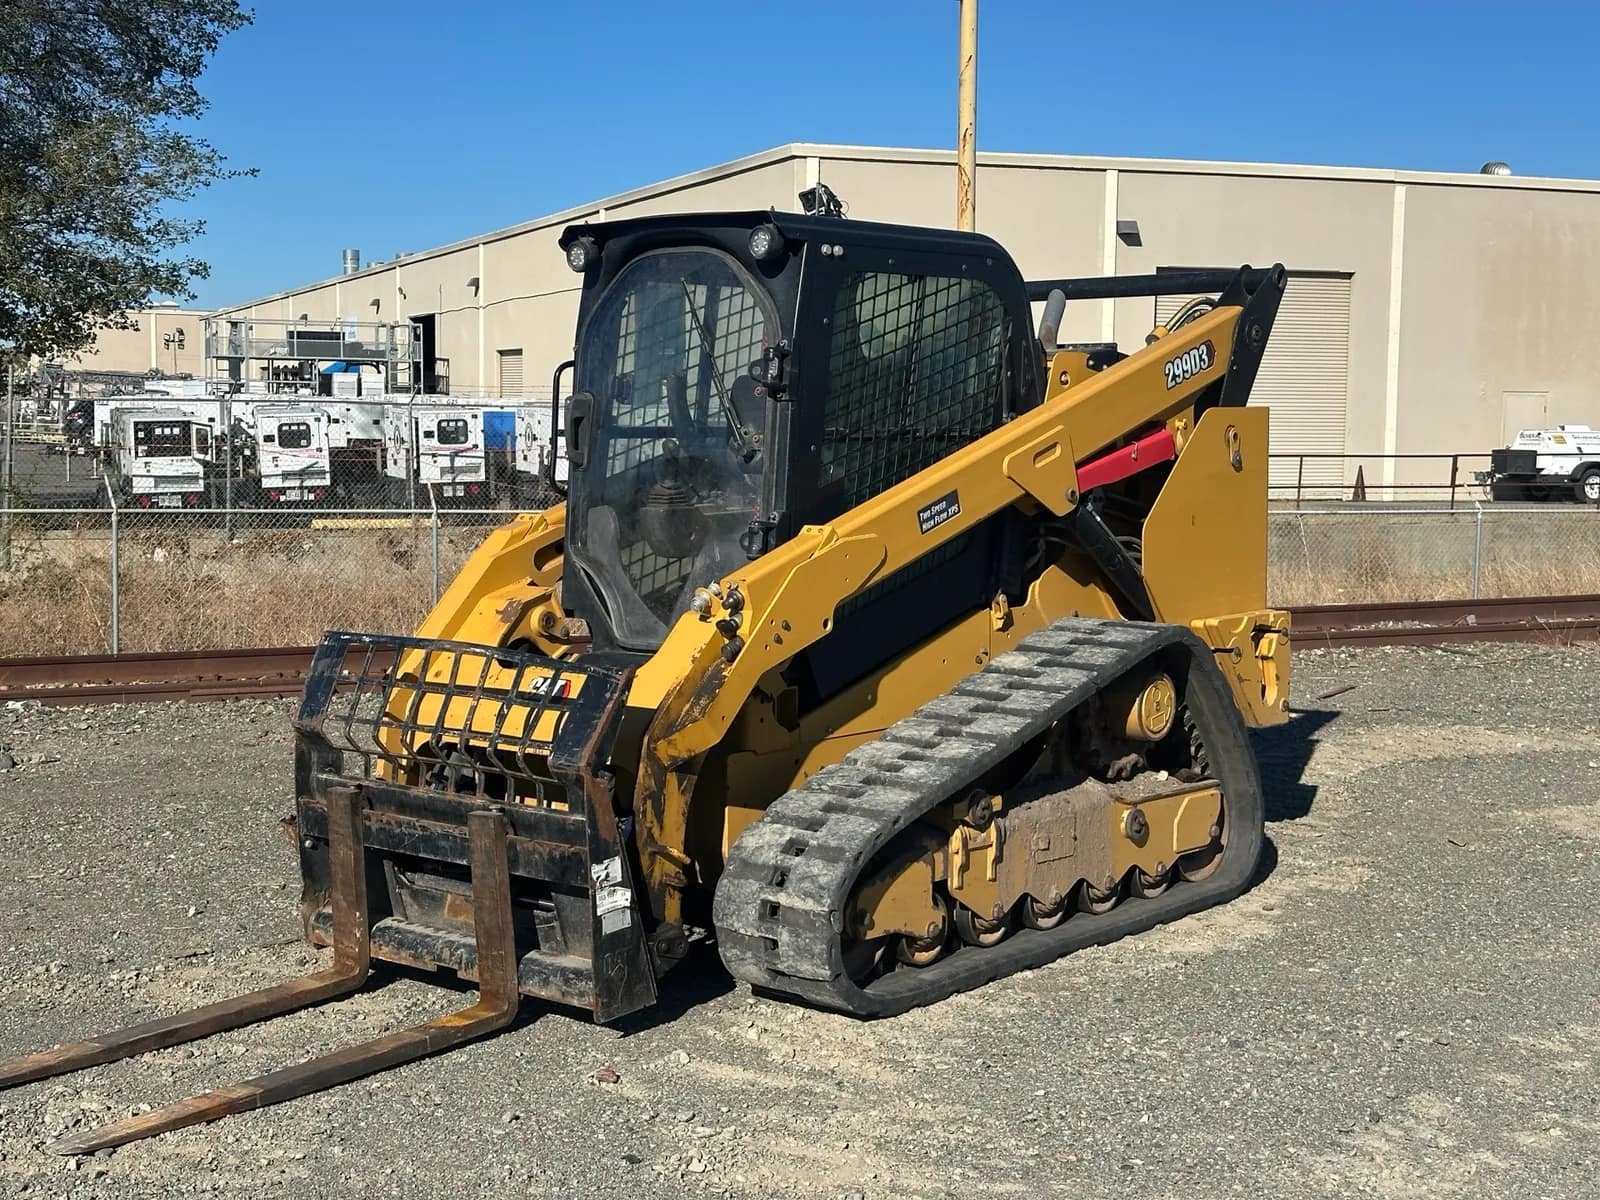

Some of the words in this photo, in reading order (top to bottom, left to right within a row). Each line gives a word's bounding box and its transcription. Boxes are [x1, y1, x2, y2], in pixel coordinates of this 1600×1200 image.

[1165, 344, 1209, 389] 299D3
[948, 504, 959, 517] XPS
[529, 677, 566, 696] CAT
